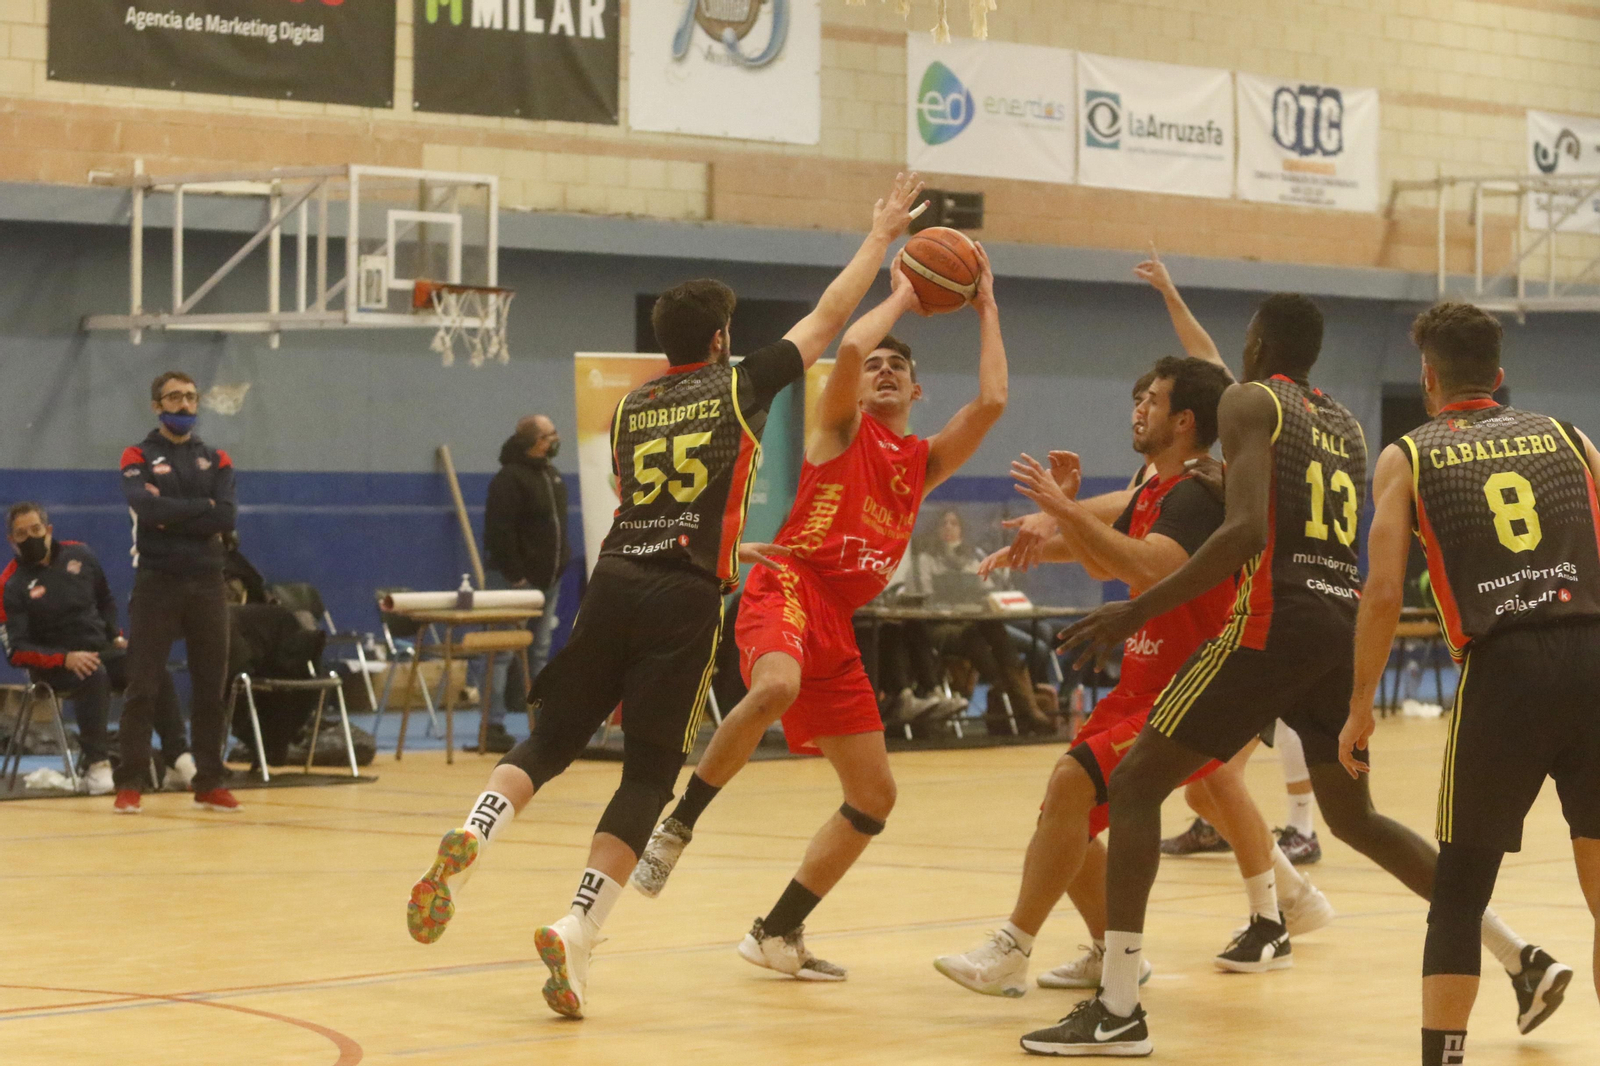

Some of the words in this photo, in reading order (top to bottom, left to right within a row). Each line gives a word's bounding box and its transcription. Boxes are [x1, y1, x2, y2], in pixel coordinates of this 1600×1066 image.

[125, 6, 183, 31] Agencia
[185, 12, 203, 31] de
[205, 14, 278, 43] Marketing
[279, 21, 324, 45] Digital
[1128, 111, 1223, 146] laArruzafa
[628, 399, 721, 433] RODRÍGUEZ
[1312, 426, 1349, 459] FALL
[1429, 434, 1558, 470] CABALLERO
[633, 430, 713, 506] 55
[1304, 460, 1358, 548] 13
[1483, 471, 1543, 554] 8
[622, 537, 677, 556] cajasur
[1306, 578, 1353, 599] cajasur
